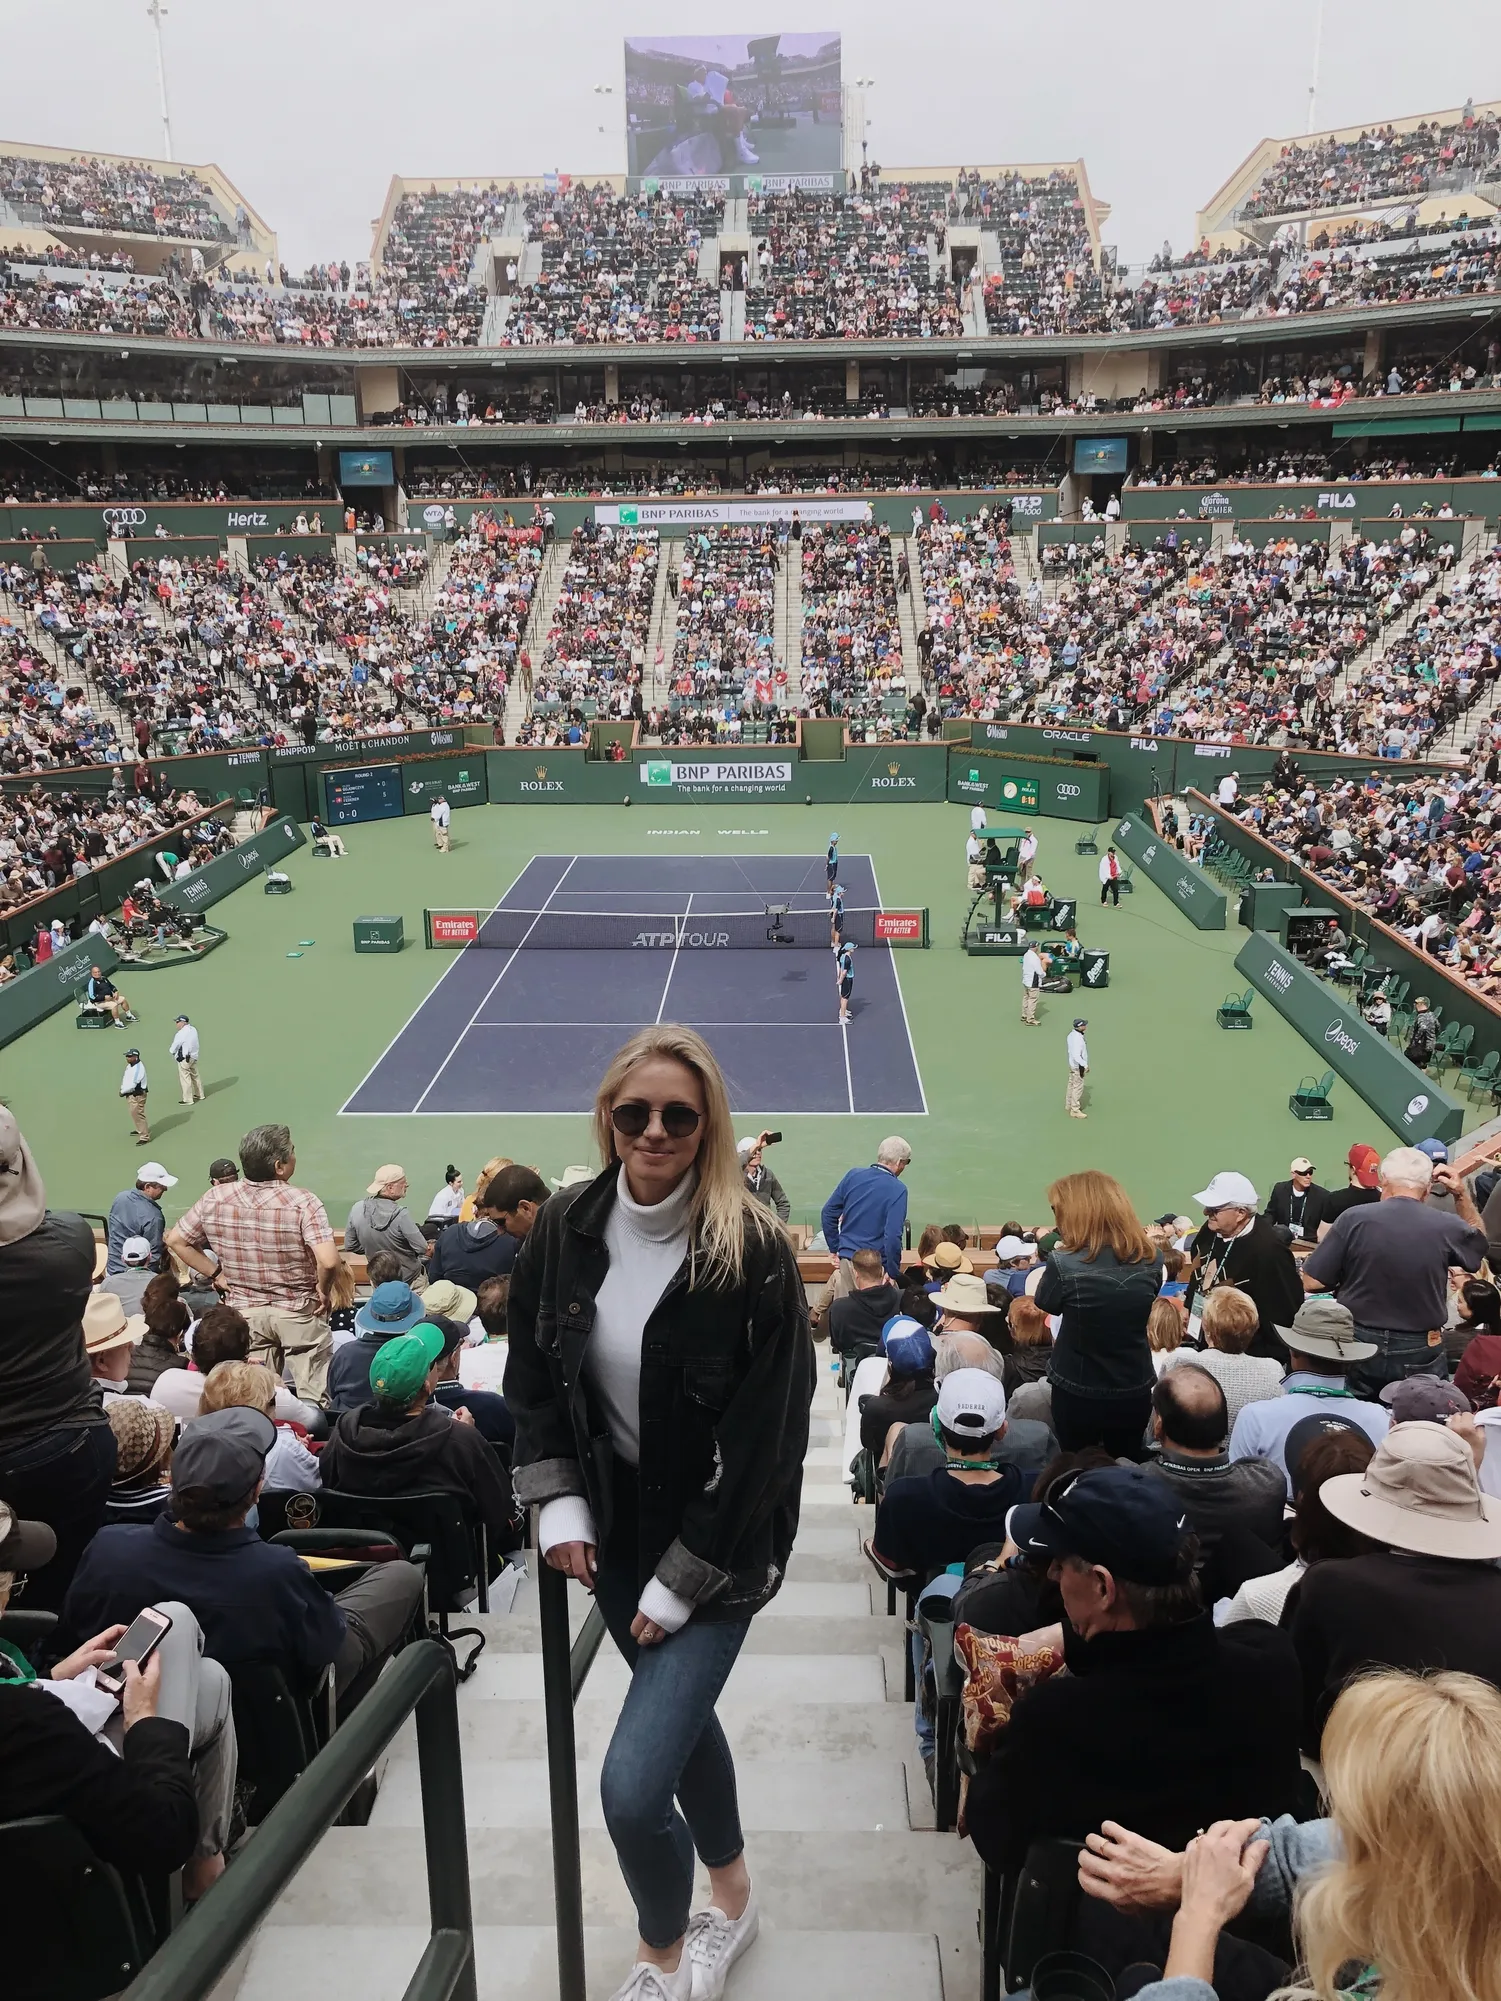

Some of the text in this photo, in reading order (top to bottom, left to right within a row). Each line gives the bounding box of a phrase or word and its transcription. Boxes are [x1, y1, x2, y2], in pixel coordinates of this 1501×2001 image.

[662, 179, 727, 190] BNP PARIBAS
[765, 177, 830, 188] BNP PARIBAS
[1011, 496, 1042, 509] ATP
[1201, 495, 1229, 507] Corona
[1318, 492, 1356, 508] FILA
[641, 509, 666, 519] BNP
[669, 508, 719, 519] PARIBAS
[739, 508, 751, 516] The
[753, 508, 770, 516] bank
[771, 508, 782, 517] for
[791, 507, 822, 517] canging
[824, 507, 844, 515] world
[1024, 508, 1042, 516] 1000
[1198, 506, 1233, 514] PREMIER
[367, 735, 410, 748] CHANDON
[1042, 729, 1090, 742] ORACLE
[1130, 738, 1158, 751] FILA
[238, 751, 260, 760] TENNIS
[275, 745, 316, 757] #BNPPO19
[1194, 744, 1231, 758] ESPN
[677, 765, 785, 779] BNP PARIBAS
[520, 781, 564, 791] ROLEX
[677, 784, 690, 792] The
[693, 784, 710, 792] bank
[711, 784, 722, 793] for
[731, 784, 763, 793] changing
[765, 783, 786, 792] world
[871, 777, 916, 787] ROLEX
[339, 811, 344, 819] 0
[351, 809, 357, 817] 0
[182, 878, 208, 899] TENNIS
[1054, 904, 1070, 927] penn
[436, 920, 474, 929] Emirates
[878, 918, 917, 927] Emirates
[631, 932, 730, 947] ATP TOUR
[985, 933, 1012, 942] FILA
[1086, 958, 1105, 984] penn
[1267, 959, 1294, 988] TENNIS
[957, 1403, 986, 1411] FEDERER
